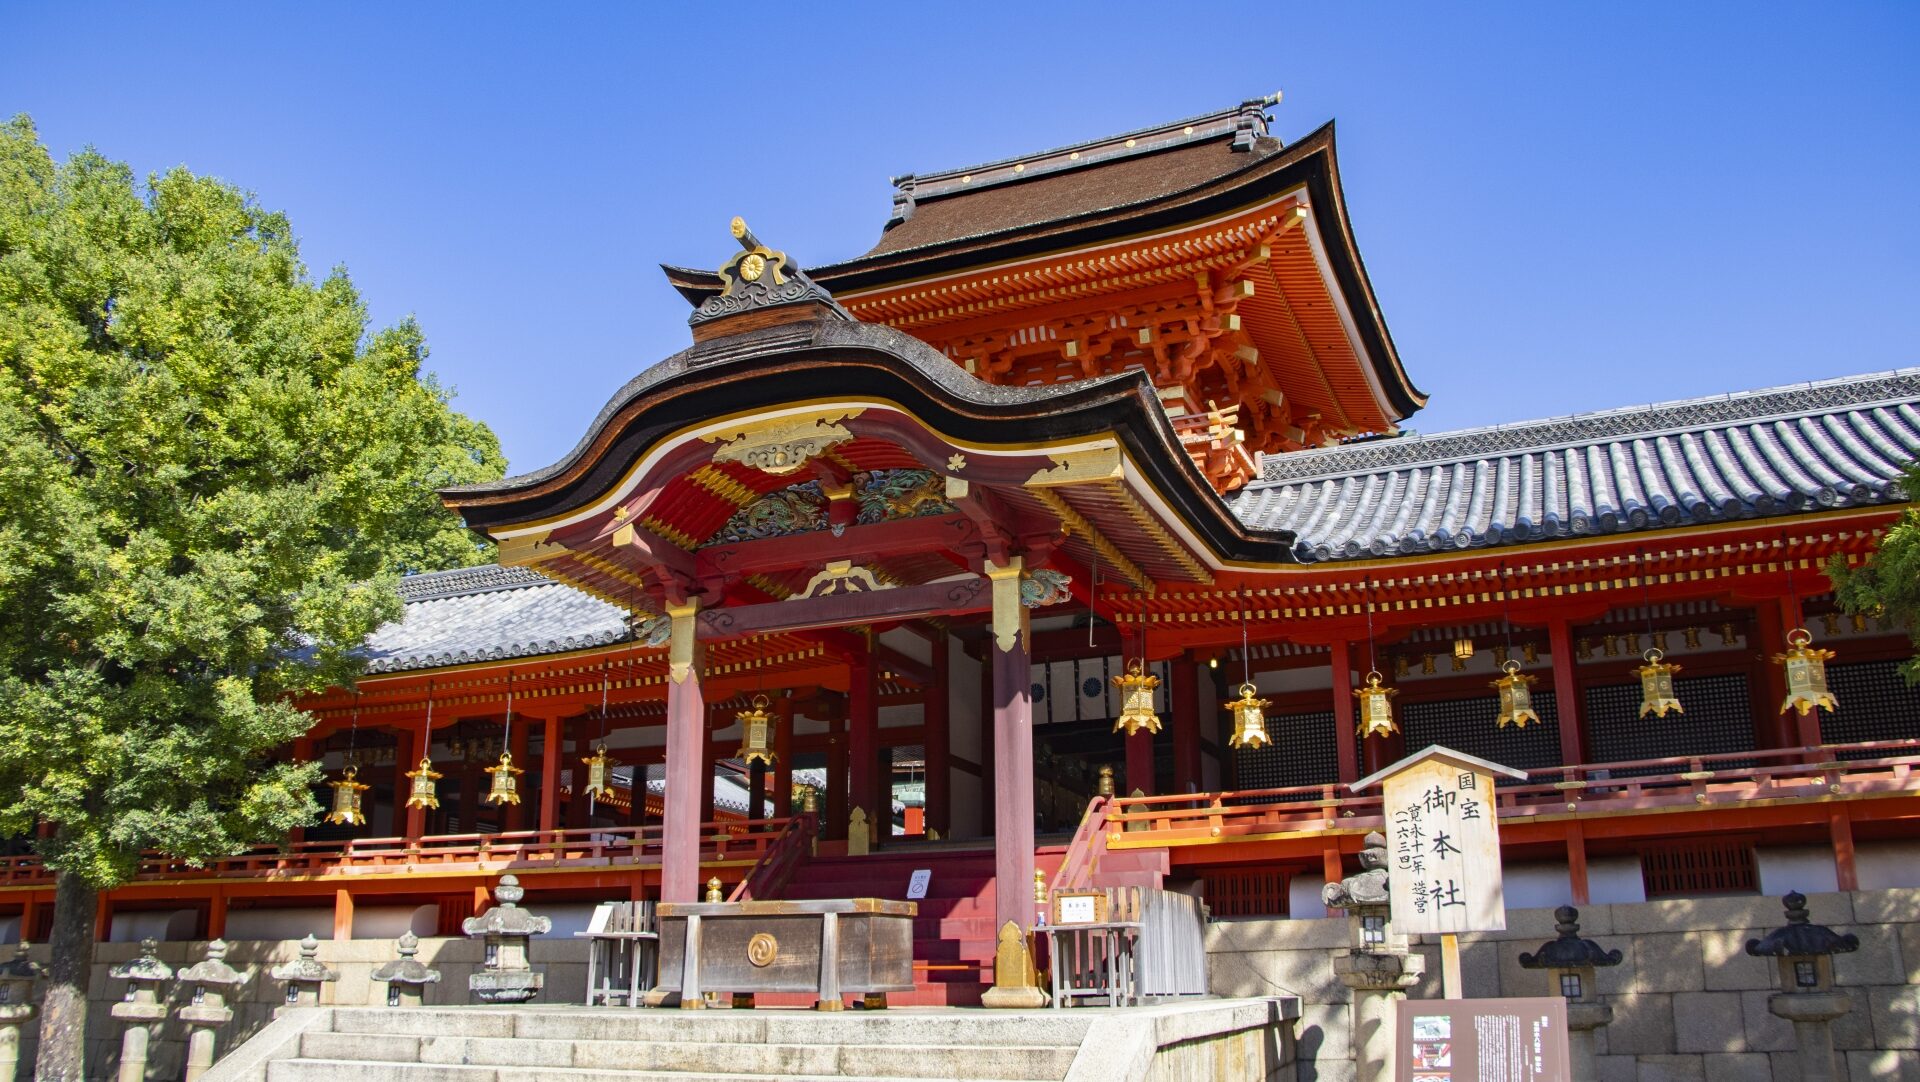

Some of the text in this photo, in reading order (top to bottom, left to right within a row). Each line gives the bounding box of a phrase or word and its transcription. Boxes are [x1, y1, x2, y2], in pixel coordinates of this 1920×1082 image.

[1458, 772, 1480, 820] 国宝
[1423, 786, 1466, 910] 御本社
